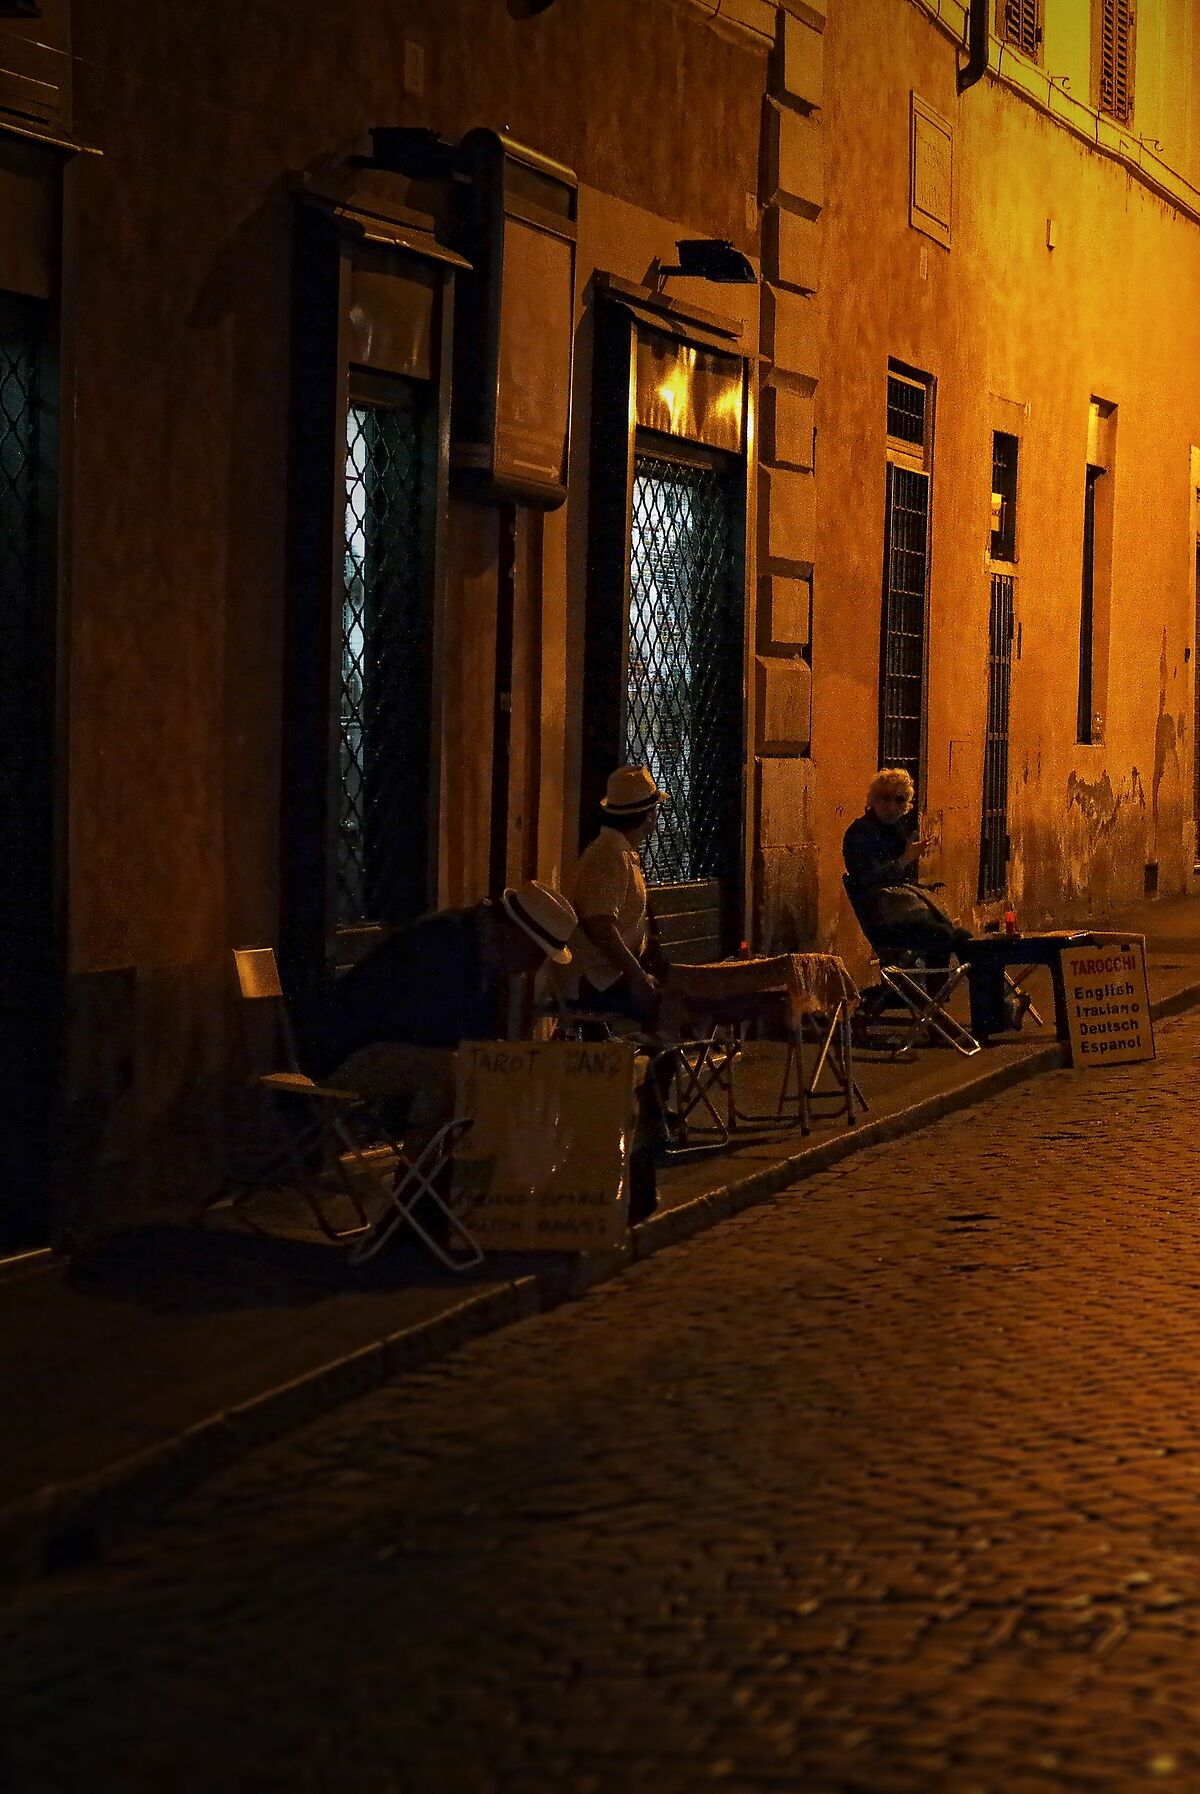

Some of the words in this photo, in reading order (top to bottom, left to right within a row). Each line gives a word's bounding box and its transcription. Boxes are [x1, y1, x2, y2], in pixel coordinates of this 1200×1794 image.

[1070, 955, 1137, 977] TAROCCHI
[1074, 982, 1135, 1000] English
[1080, 1019, 1139, 1036] Deutsch
[470, 1049, 542, 1074] TAROT
